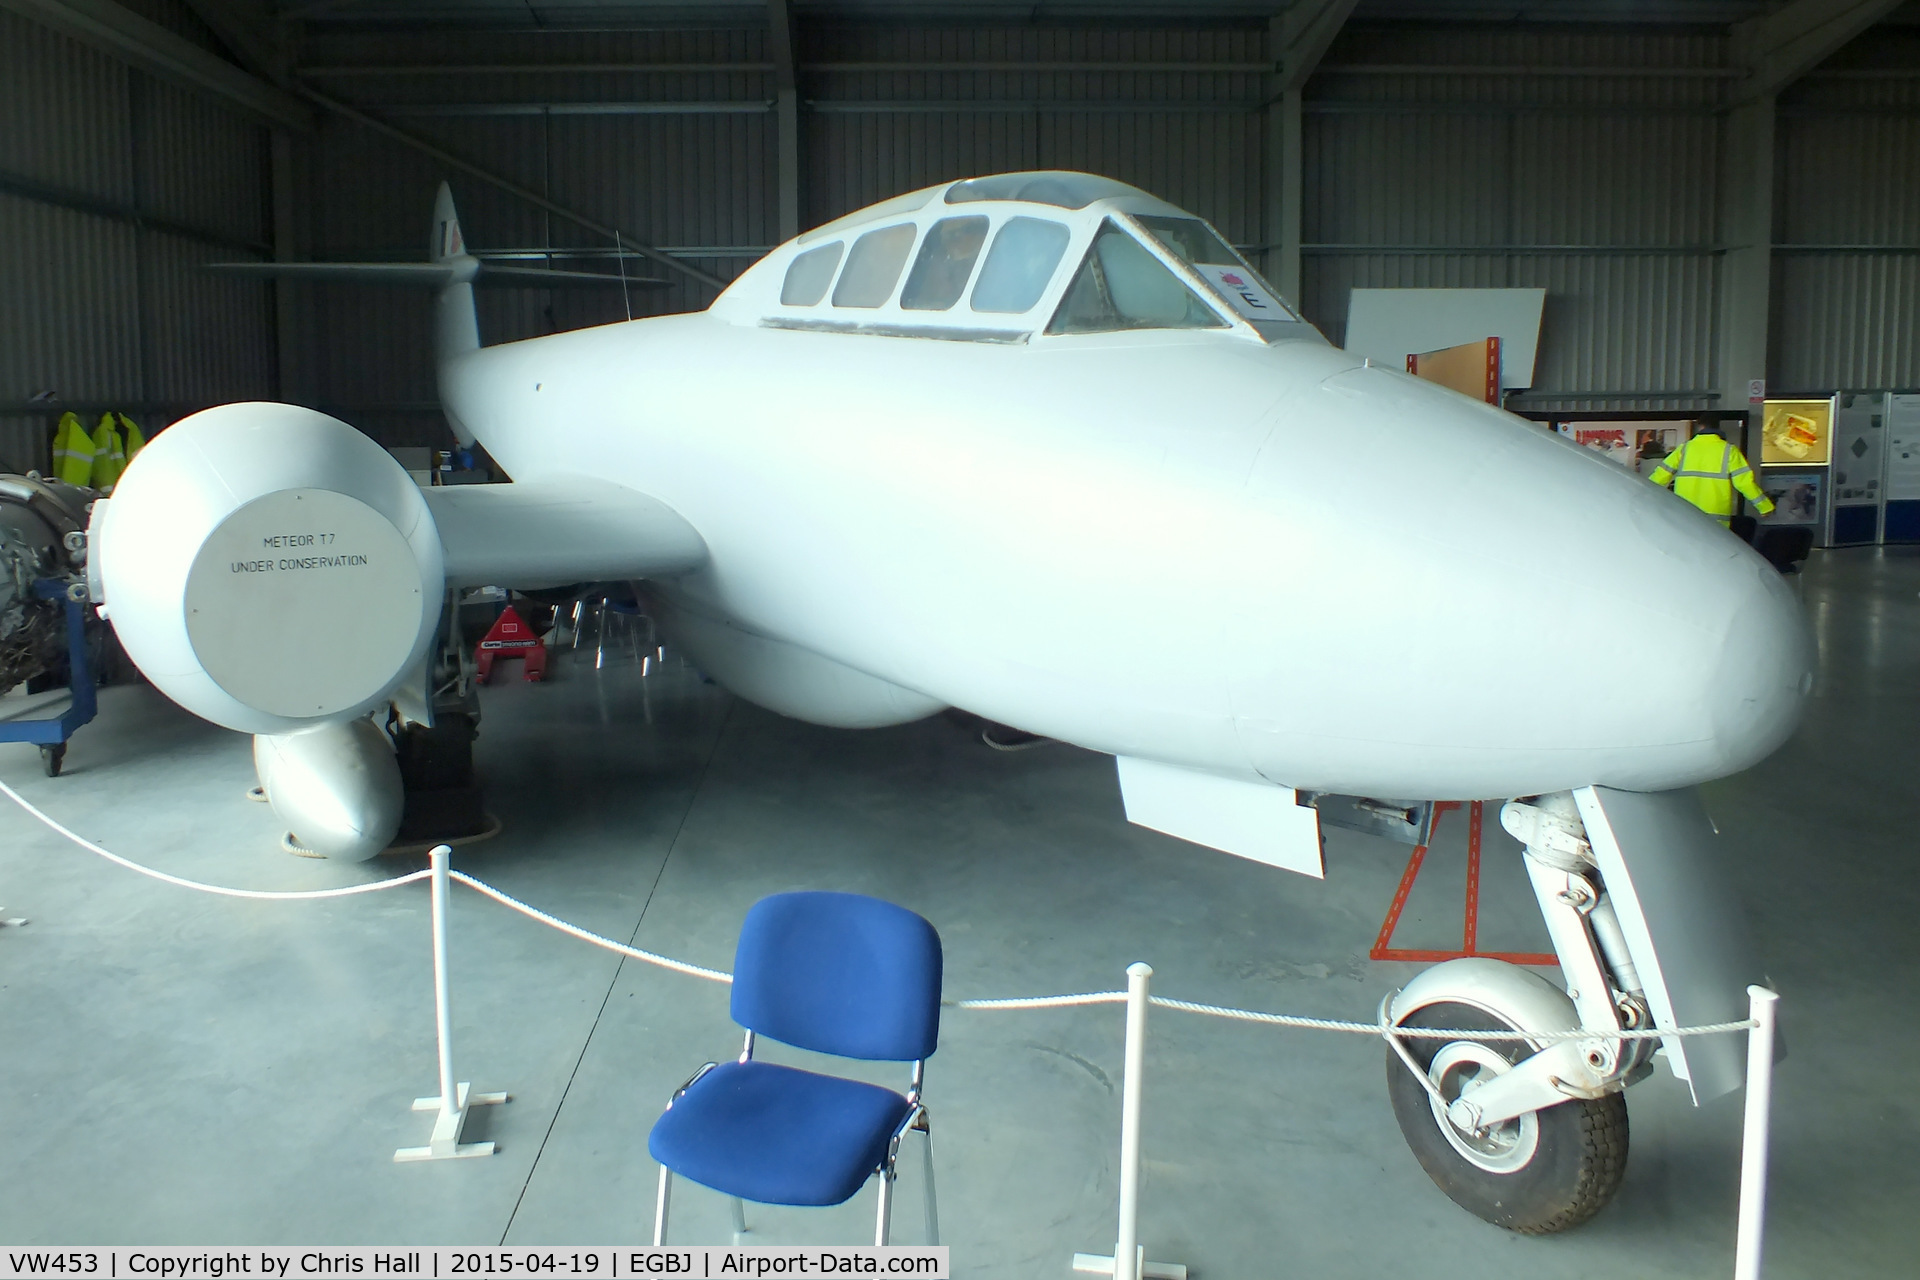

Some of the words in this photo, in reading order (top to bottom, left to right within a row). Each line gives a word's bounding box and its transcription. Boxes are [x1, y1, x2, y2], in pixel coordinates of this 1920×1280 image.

[1239, 292, 1267, 309] E
[264, 534, 314, 547] METEOR
[320, 533, 336, 545] T7
[231, 560, 275, 573] UNDER
[279, 554, 368, 571] CONSERVATION
